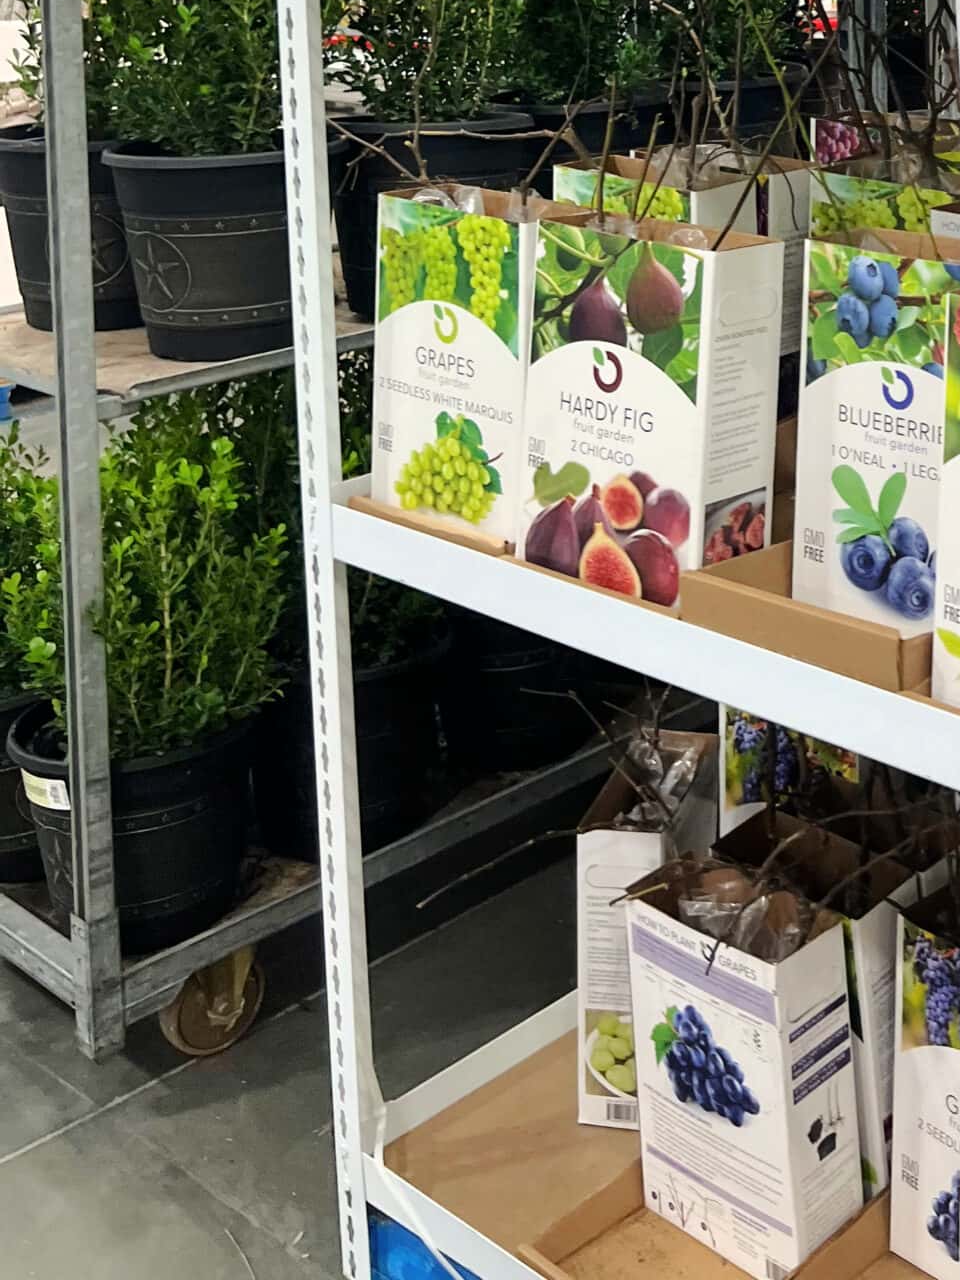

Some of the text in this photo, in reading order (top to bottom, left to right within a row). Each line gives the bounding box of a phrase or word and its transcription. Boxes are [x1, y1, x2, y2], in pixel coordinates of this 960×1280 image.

[415, 346, 475, 378] GRAPES
[387, 379, 431, 401] SEEDLESS
[432, 391, 463, 411] WHITE
[464, 400, 513, 425] MARQUIS
[560, 391, 654, 433] HARDY FIG
[838, 403, 943, 445] BLUEBERRIE
[579, 441, 634, 467] CHICAGO
[864, 431, 928, 457] fruit garden
[911, 464, 941, 482] LEG
[804, 545, 825, 564] FREE
